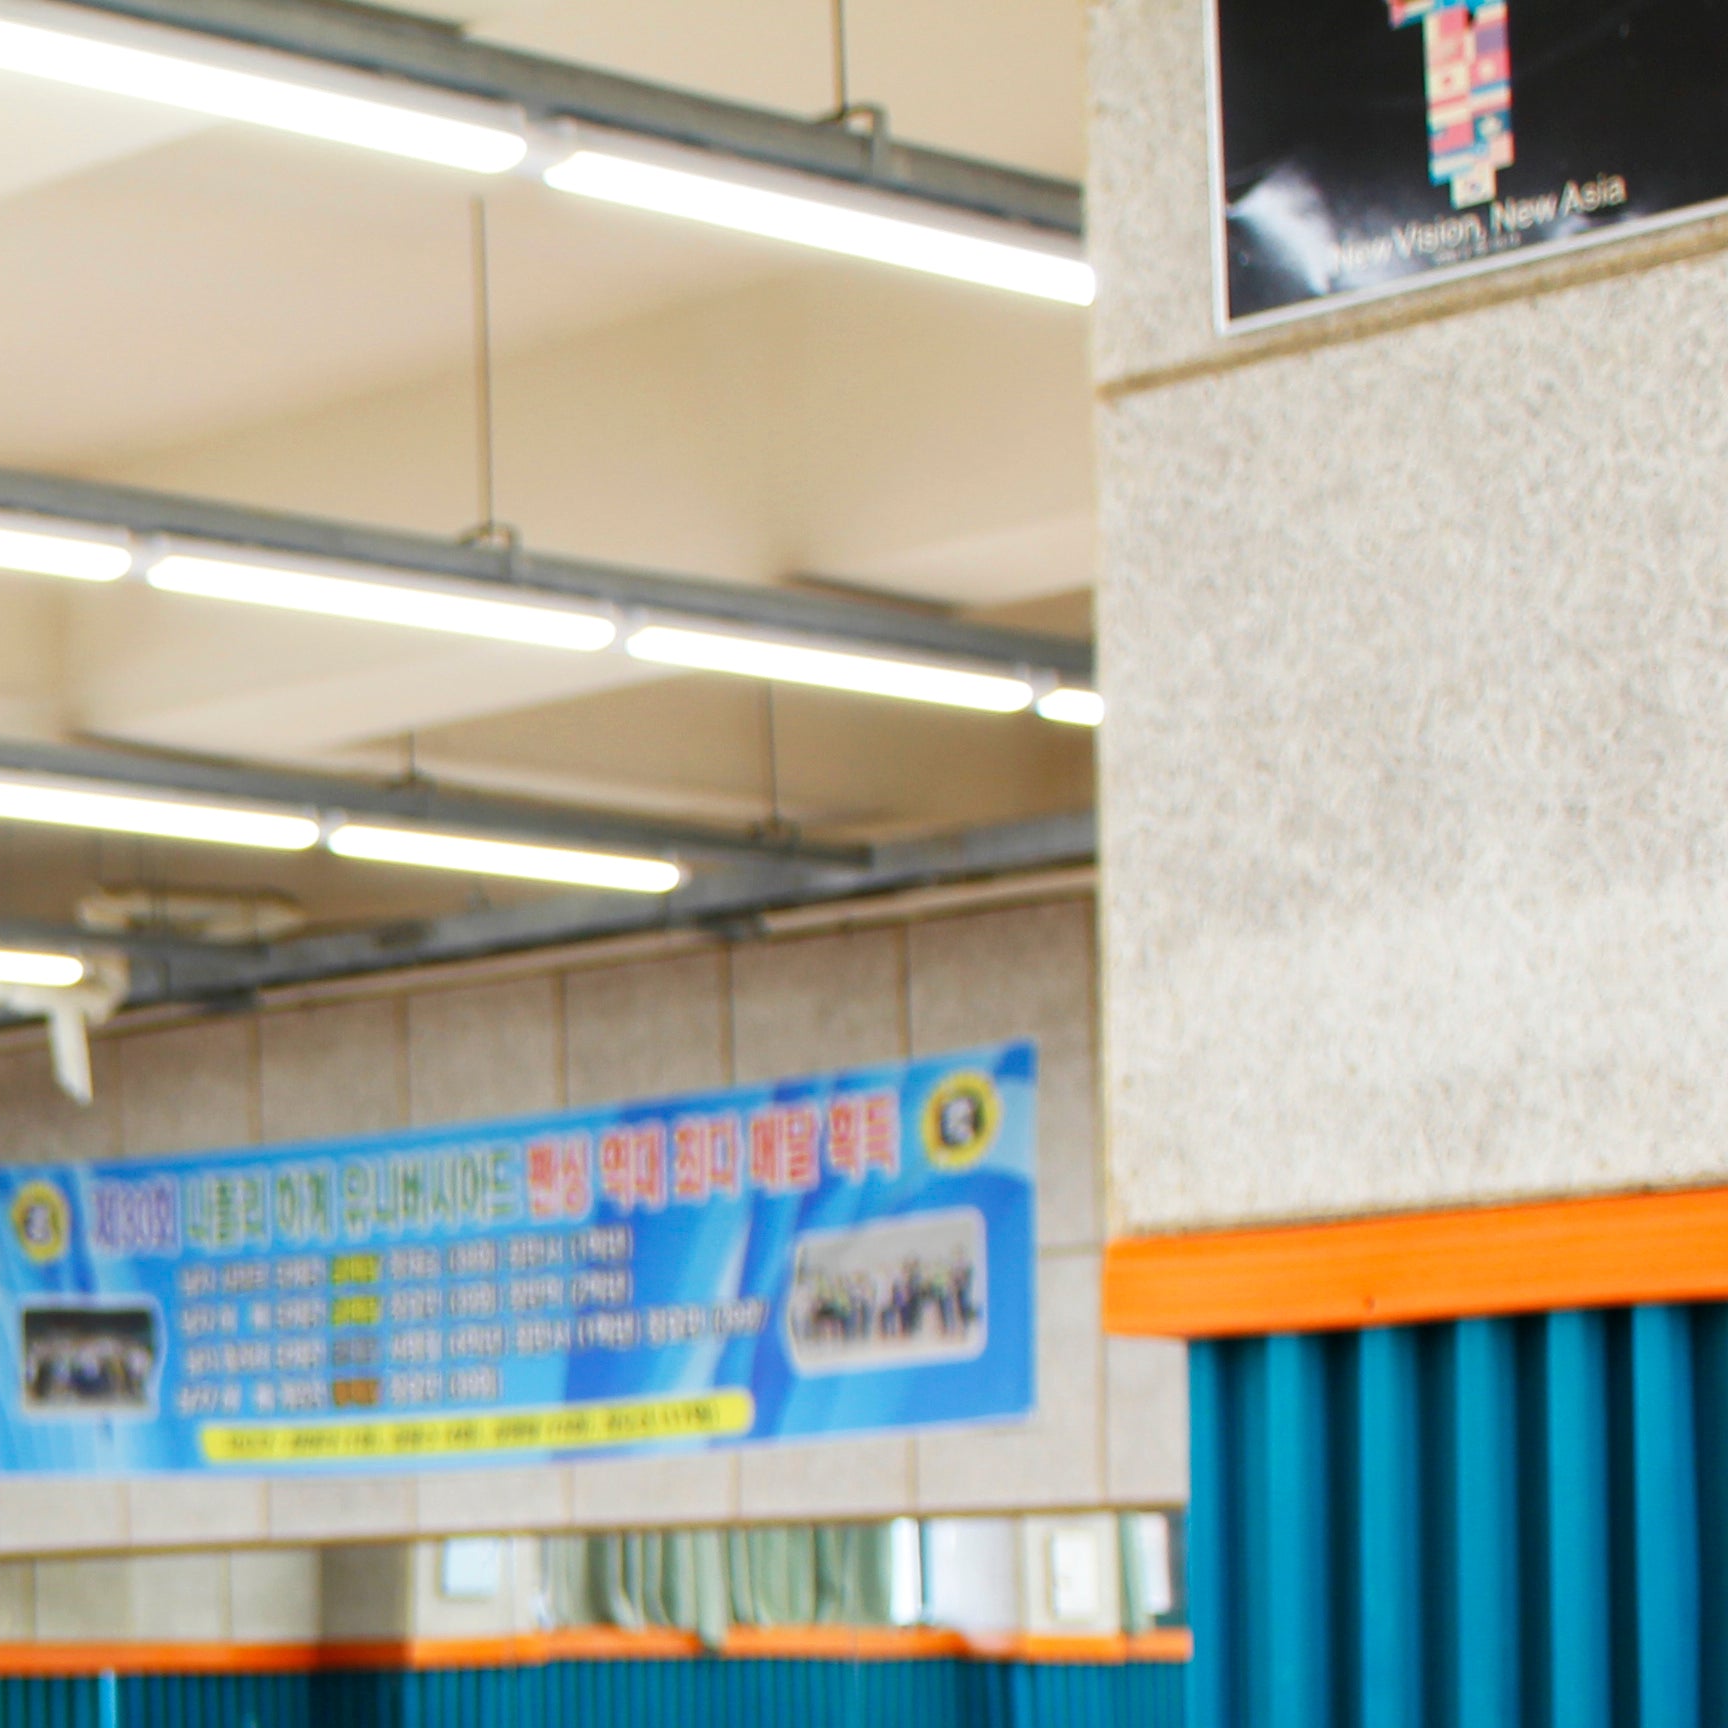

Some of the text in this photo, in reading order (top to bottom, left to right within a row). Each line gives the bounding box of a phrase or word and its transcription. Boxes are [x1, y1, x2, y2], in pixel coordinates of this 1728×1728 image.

[1490, 194, 1558, 235] New
[1558, 172, 1627, 217] Asia
[342, 1142, 520, 1238] 유니버시아드
[526, 1134, 592, 1221] 펜싱
[673, 1113, 742, 1204] 최다
[748, 1103, 820, 1195] 메달
